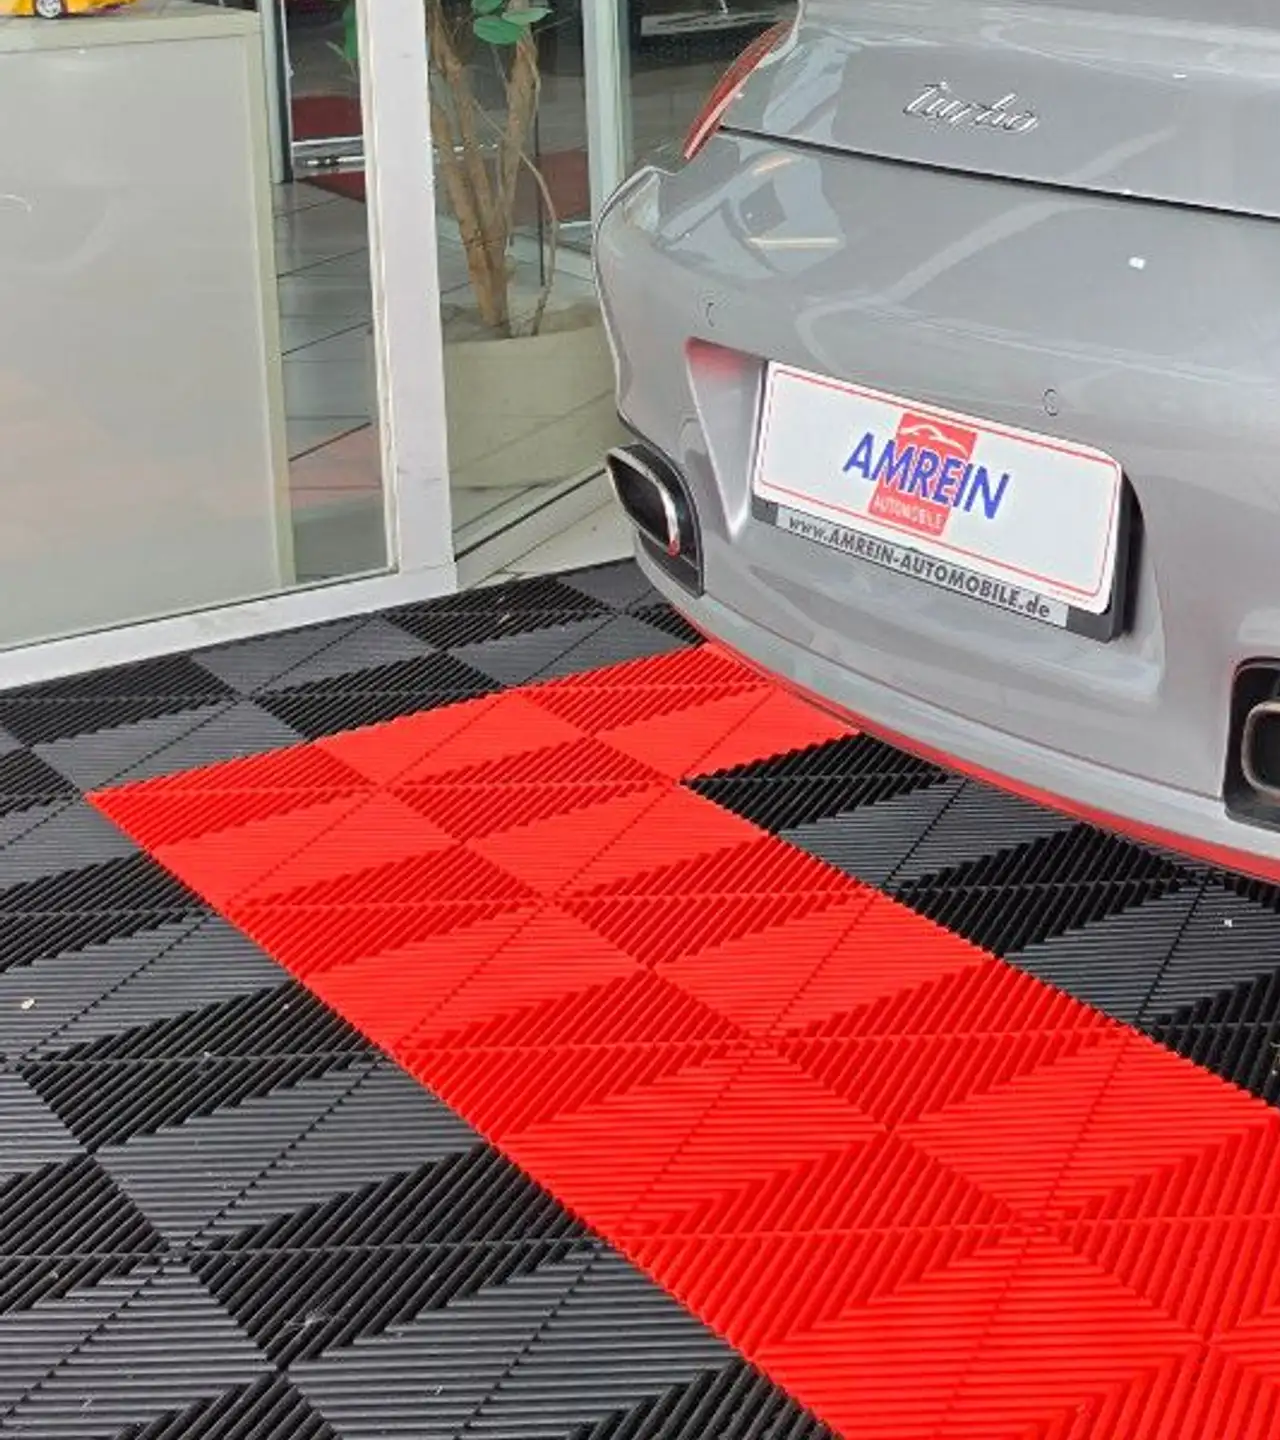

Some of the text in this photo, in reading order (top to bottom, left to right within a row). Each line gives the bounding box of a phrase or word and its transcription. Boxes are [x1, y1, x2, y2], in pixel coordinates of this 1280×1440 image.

[843, 432, 1009, 519] AMREIN
[873, 496, 943, 529] AUTOMOBILE
[789, 516, 1050, 617] www.AMREIN-AUTOMOBILE.de
